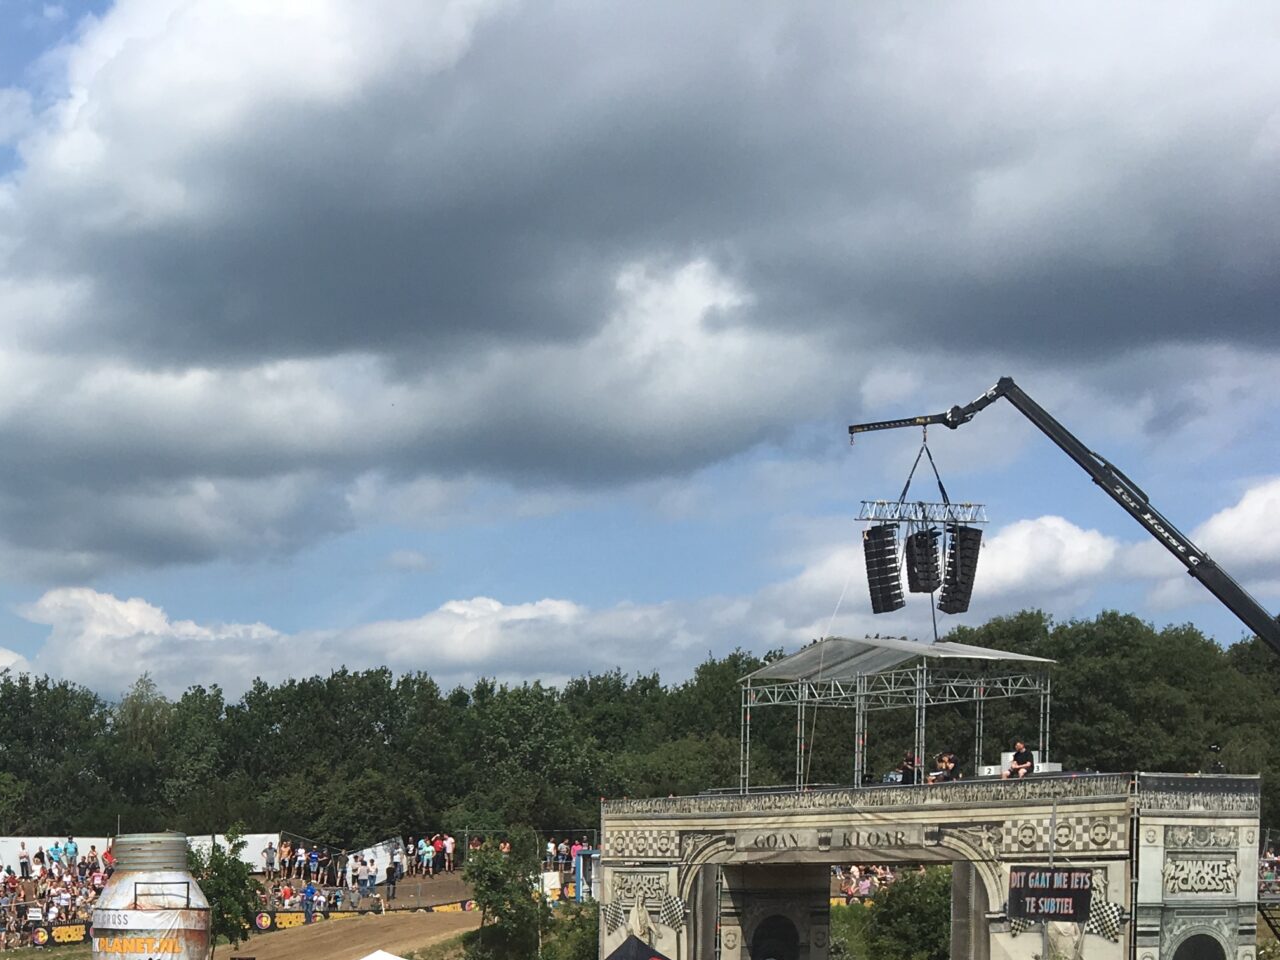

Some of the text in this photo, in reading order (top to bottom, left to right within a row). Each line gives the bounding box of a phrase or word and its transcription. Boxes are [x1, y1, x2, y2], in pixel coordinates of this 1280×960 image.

[1114, 485, 1139, 509] Ter
[1142, 513, 1186, 552] Horst
[753, 833, 799, 848] GOAN
[842, 831, 906, 848] KLOAR
[1174, 860, 1228, 878] ZWARTE
[1011, 871, 1091, 889] DIT GAAT ME IETS
[1178, 874, 1225, 893] CROSS
[1025, 897, 1073, 914] TE SUBTIEL
